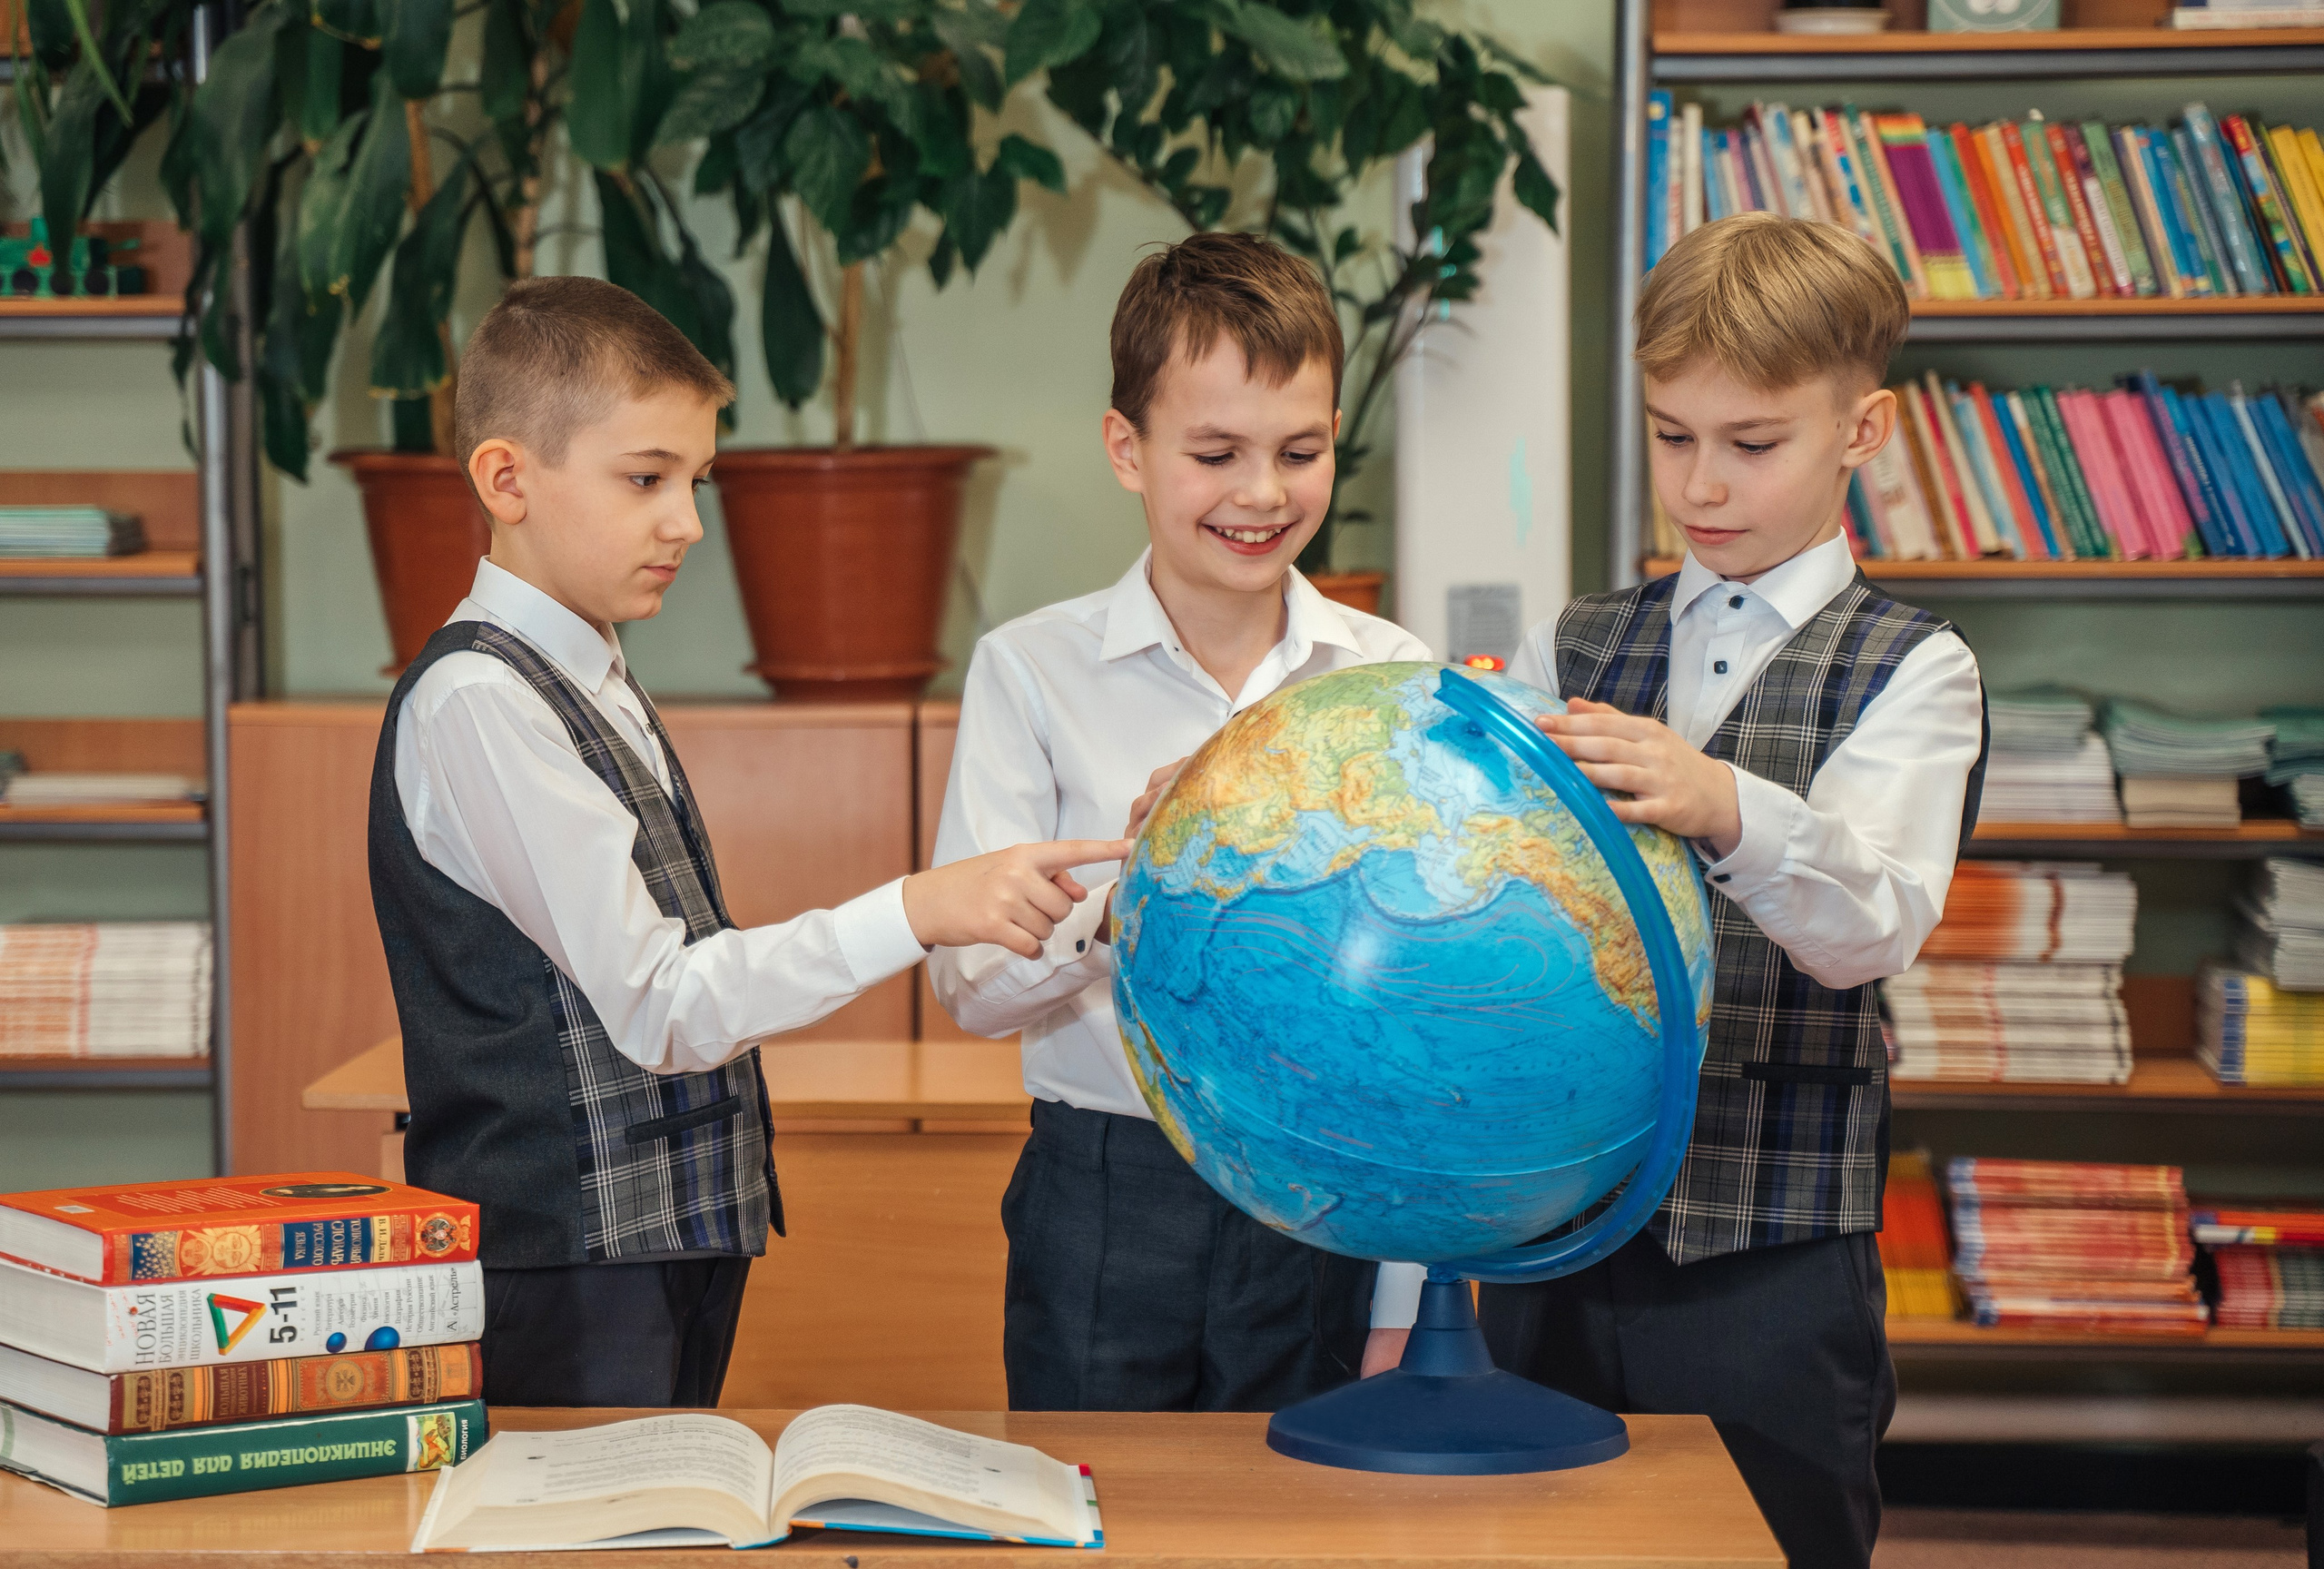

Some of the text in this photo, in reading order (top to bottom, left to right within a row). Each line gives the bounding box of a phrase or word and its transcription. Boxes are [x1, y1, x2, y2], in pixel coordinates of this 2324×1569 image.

[294, 1231, 307, 1260] ЯЗЫКА
[311, 1222, 326, 1267] РУССКОГО
[330, 1220, 346, 1266] СЛОВАРЬ
[350, 1218, 363, 1264] ТОЛКОВЫЙ
[378, 1218, 388, 1261] В. И. Даль
[337, 1298, 346, 1326] Алгебра
[348, 1293, 358, 1328] Геометрия
[360, 1297, 369, 1323] Физика
[371, 1297, 379, 1320] Химия
[383, 1291, 391, 1324] Биология
[394, 1289, 404, 1325] География
[405, 1278, 415, 1333] История России
[416, 1275, 426, 1334] Обществознание
[428, 1292, 437, 1333] Английский
[448, 1267, 462, 1317] «Астрель»
[134, 1293, 157, 1365] НОВАЯ
[158, 1294, 175, 1363] БОЛЬШАЯ
[177, 1289, 189, 1362] ЭНЦИКЛОПЕДИЯ
[189, 1288, 202, 1360] ШКОЛЬНИКА
[269, 1287, 299, 1344] 5-11
[312, 1308, 322, 1337] Русский
[219, 1368, 230, 1416] БОЛЬШАЯ
[237, 1366, 249, 1415] ЖИВОТНЫХ
[121, 1438, 398, 1486] ЭНЦИКЛОПЕДИЯ ДЛЯ ДЕТЕЙ
[459, 1418, 469, 1460] БИОЛОГИЯ
